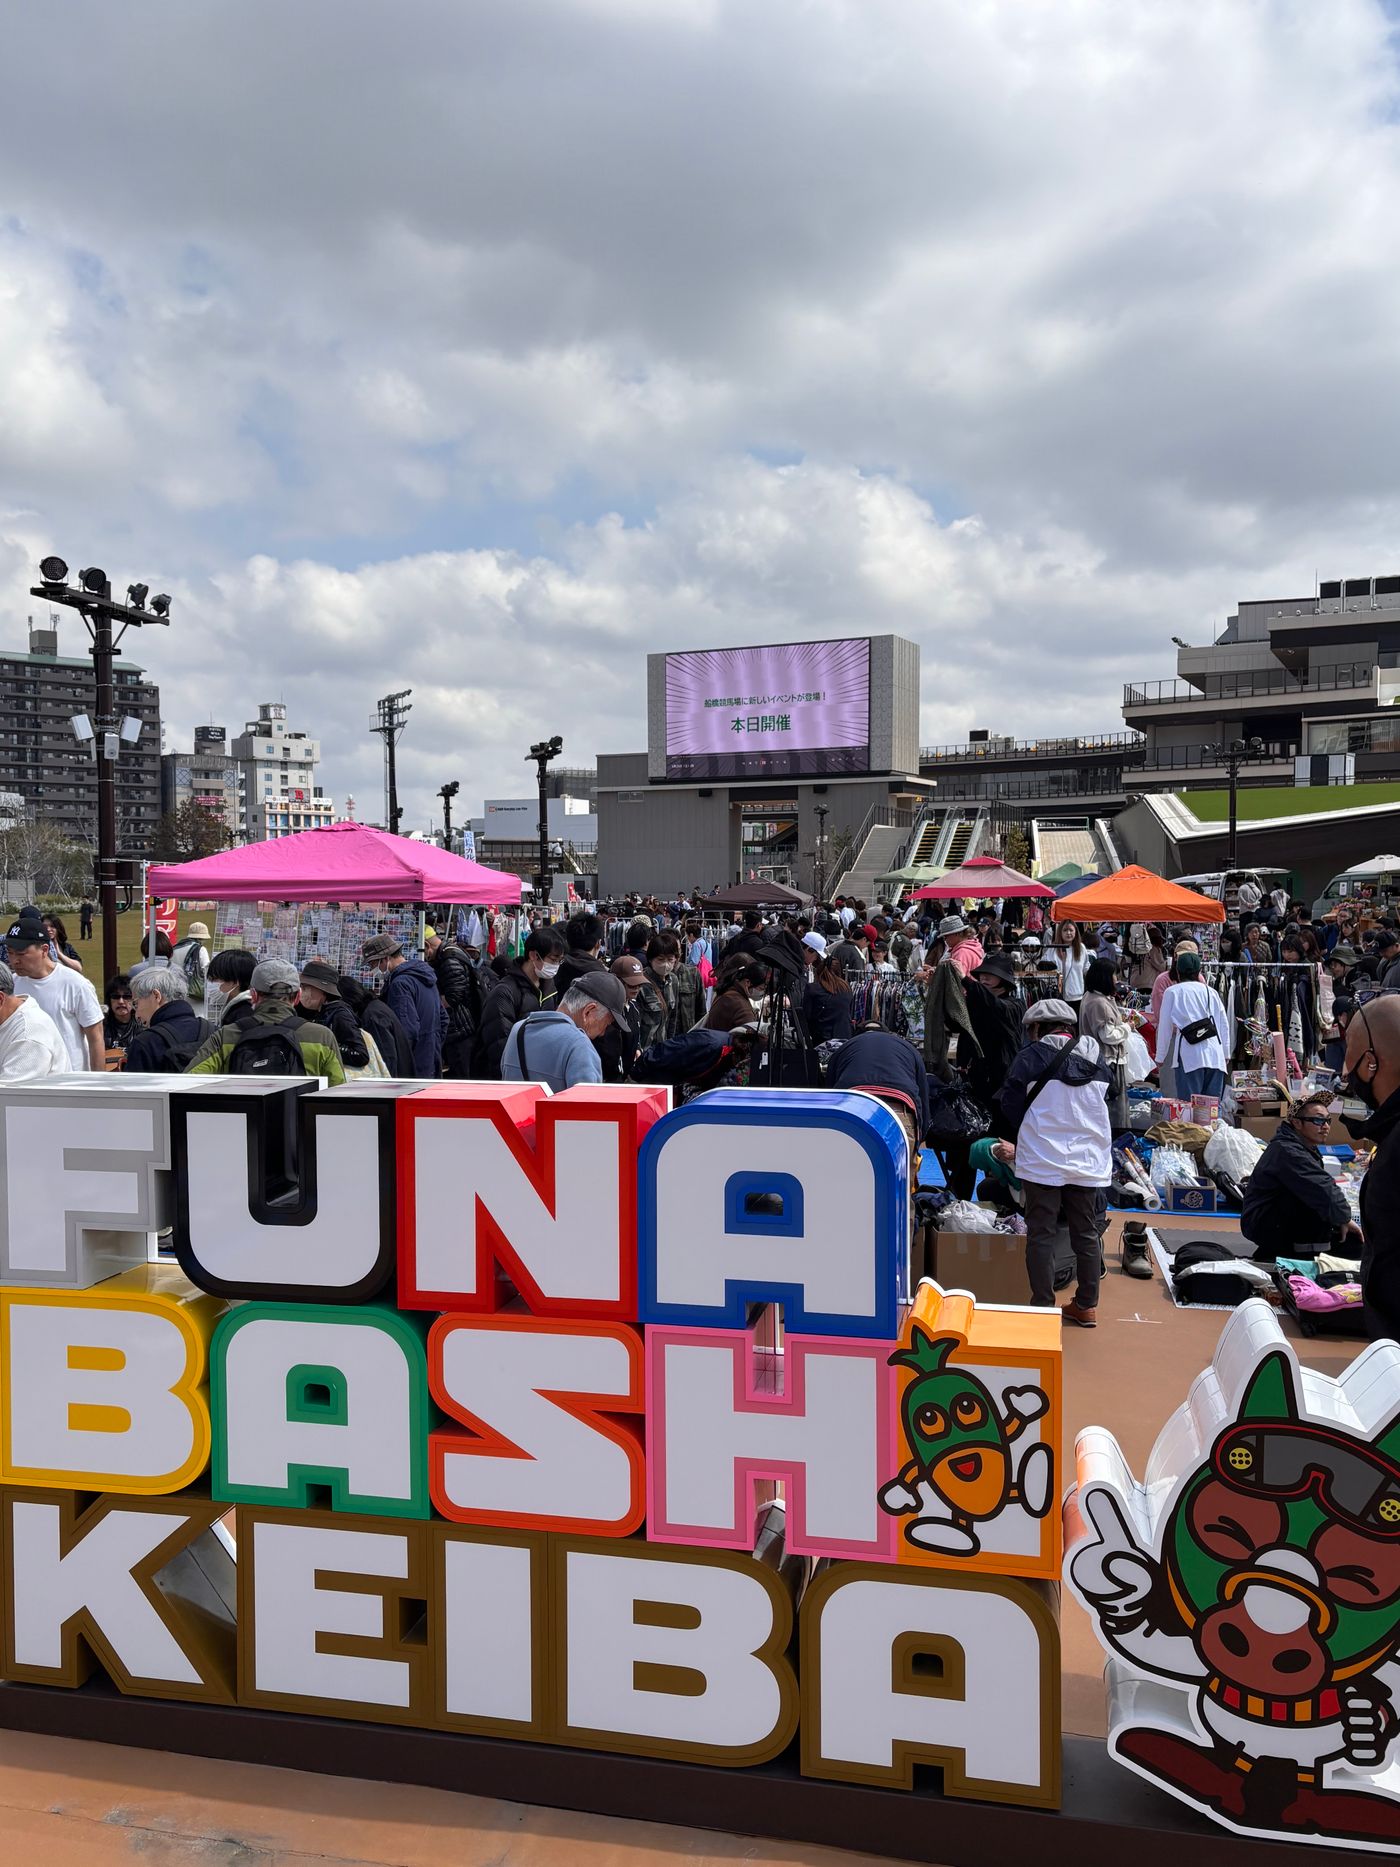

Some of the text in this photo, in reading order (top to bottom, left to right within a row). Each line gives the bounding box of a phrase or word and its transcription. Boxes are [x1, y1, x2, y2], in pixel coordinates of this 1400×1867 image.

[731, 714, 791, 733] 本日開催
[4, 1100, 880, 1322] FUNA
[12, 1498, 1040, 1784] KEIBA
